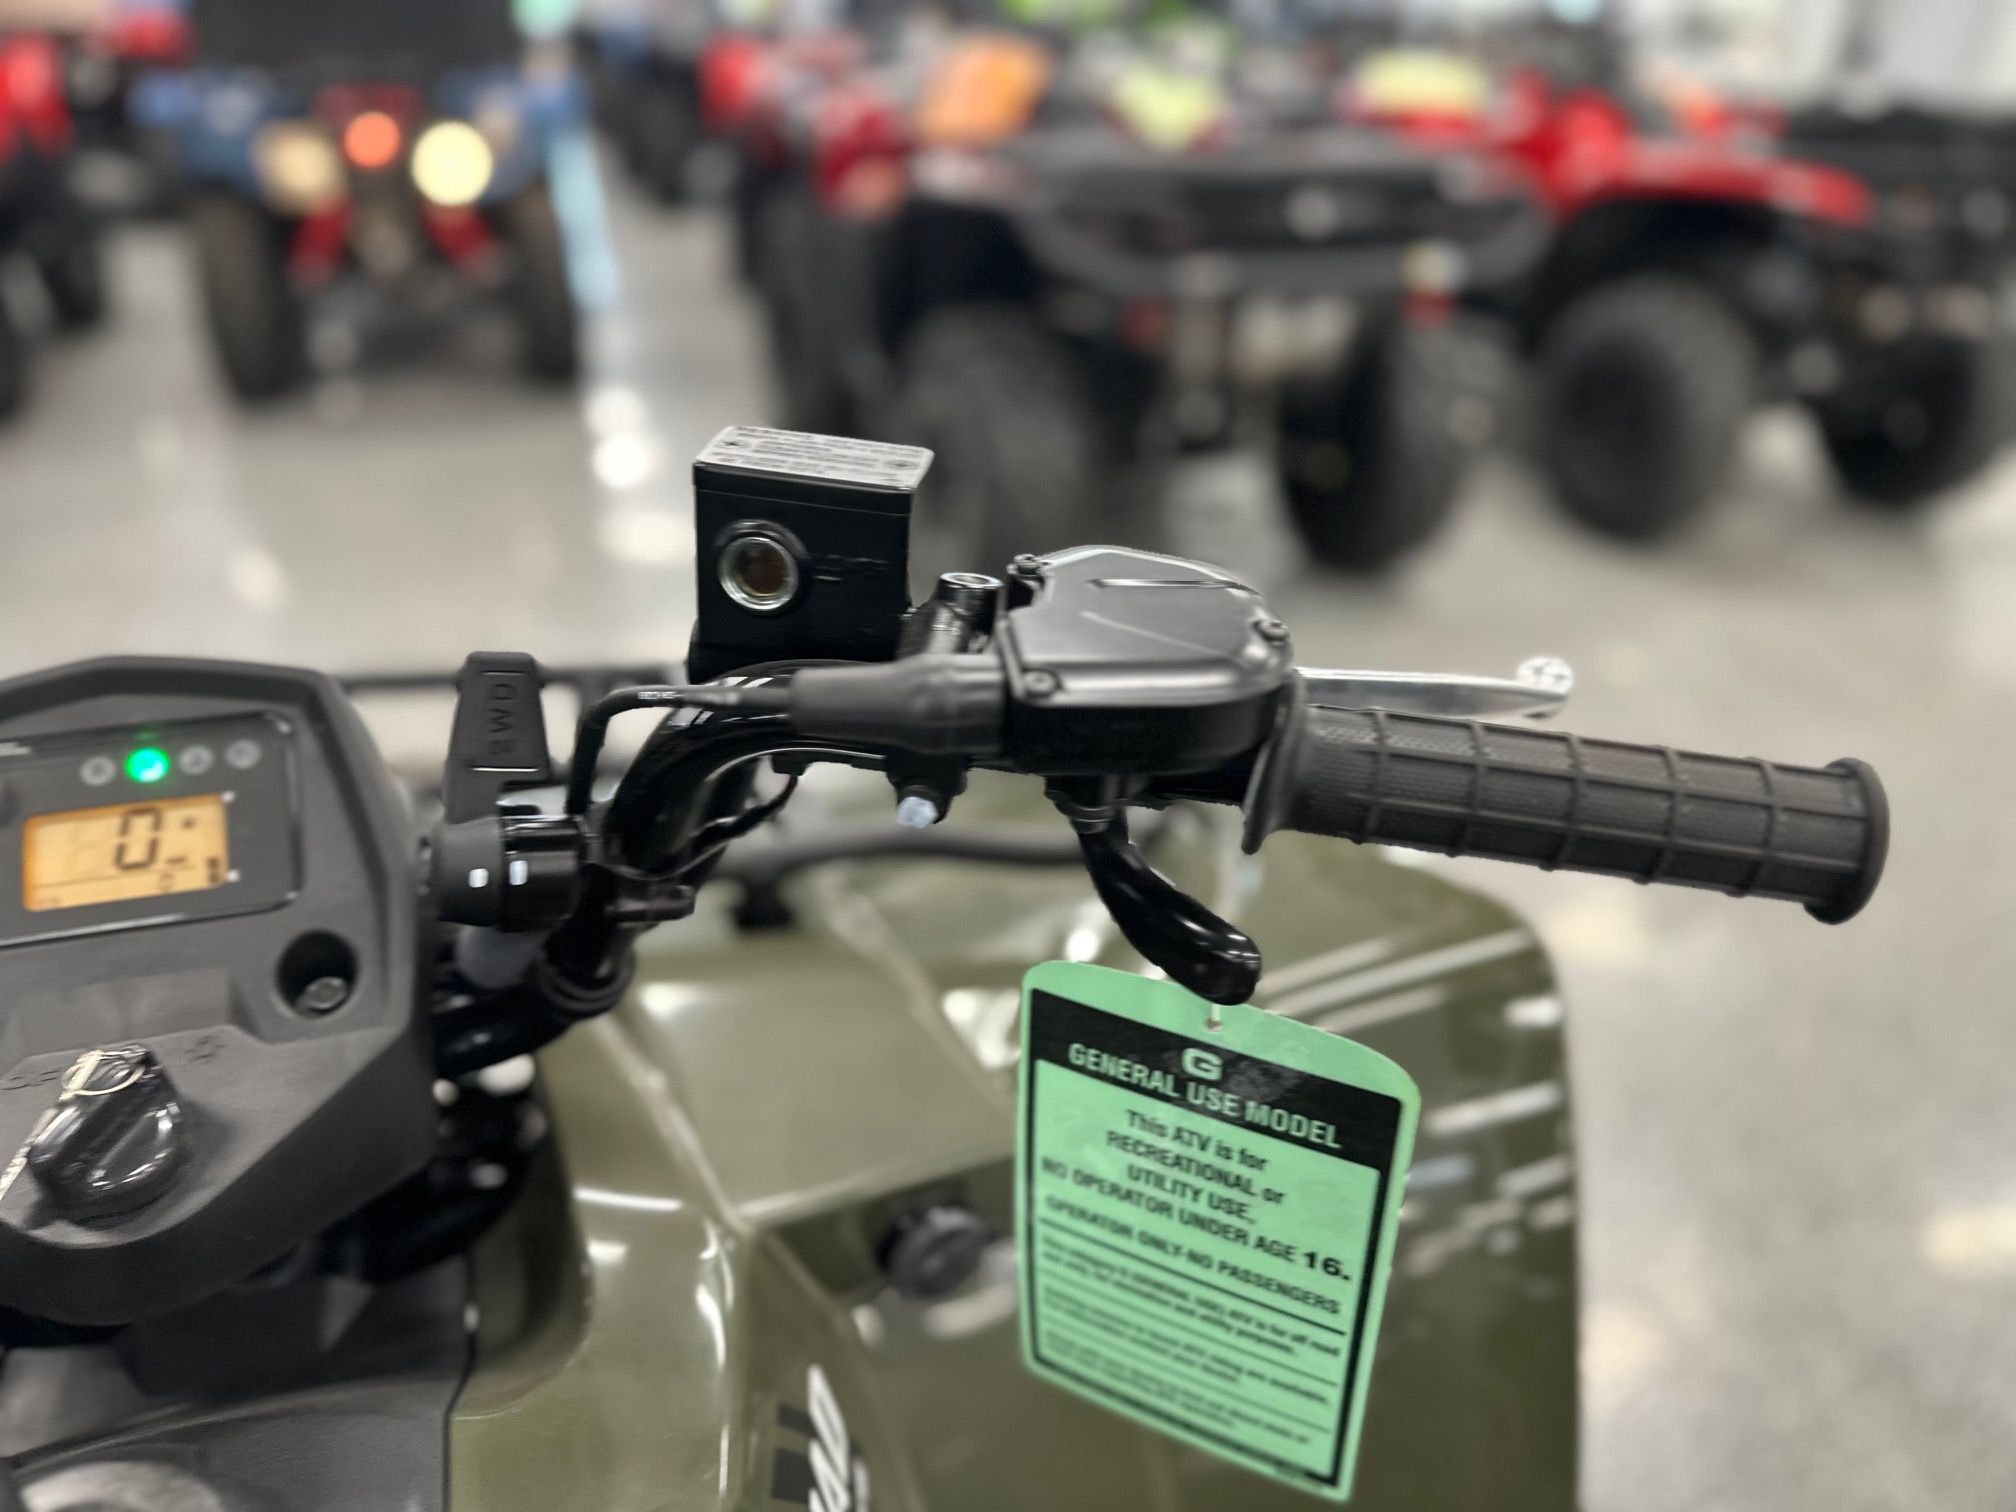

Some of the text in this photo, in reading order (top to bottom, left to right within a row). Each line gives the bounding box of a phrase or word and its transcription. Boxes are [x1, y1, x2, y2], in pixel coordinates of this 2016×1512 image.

[1068, 1043, 1342, 1149] GENERAL USE MODEL
[1182, 1048, 1222, 1081] G
[1106, 1129, 1287, 1205] RECREATIONAL or
[1126, 1109, 1267, 1170] This ATV is for
[1042, 1156, 1352, 1281] NO OPERATOR UNDER AGE 16.
[1127, 1164, 1204, 1202] UTILITY
[1046, 1195, 1133, 1239] OPERATOR
[1218, 1260, 1341, 1315] PASSENGERS
